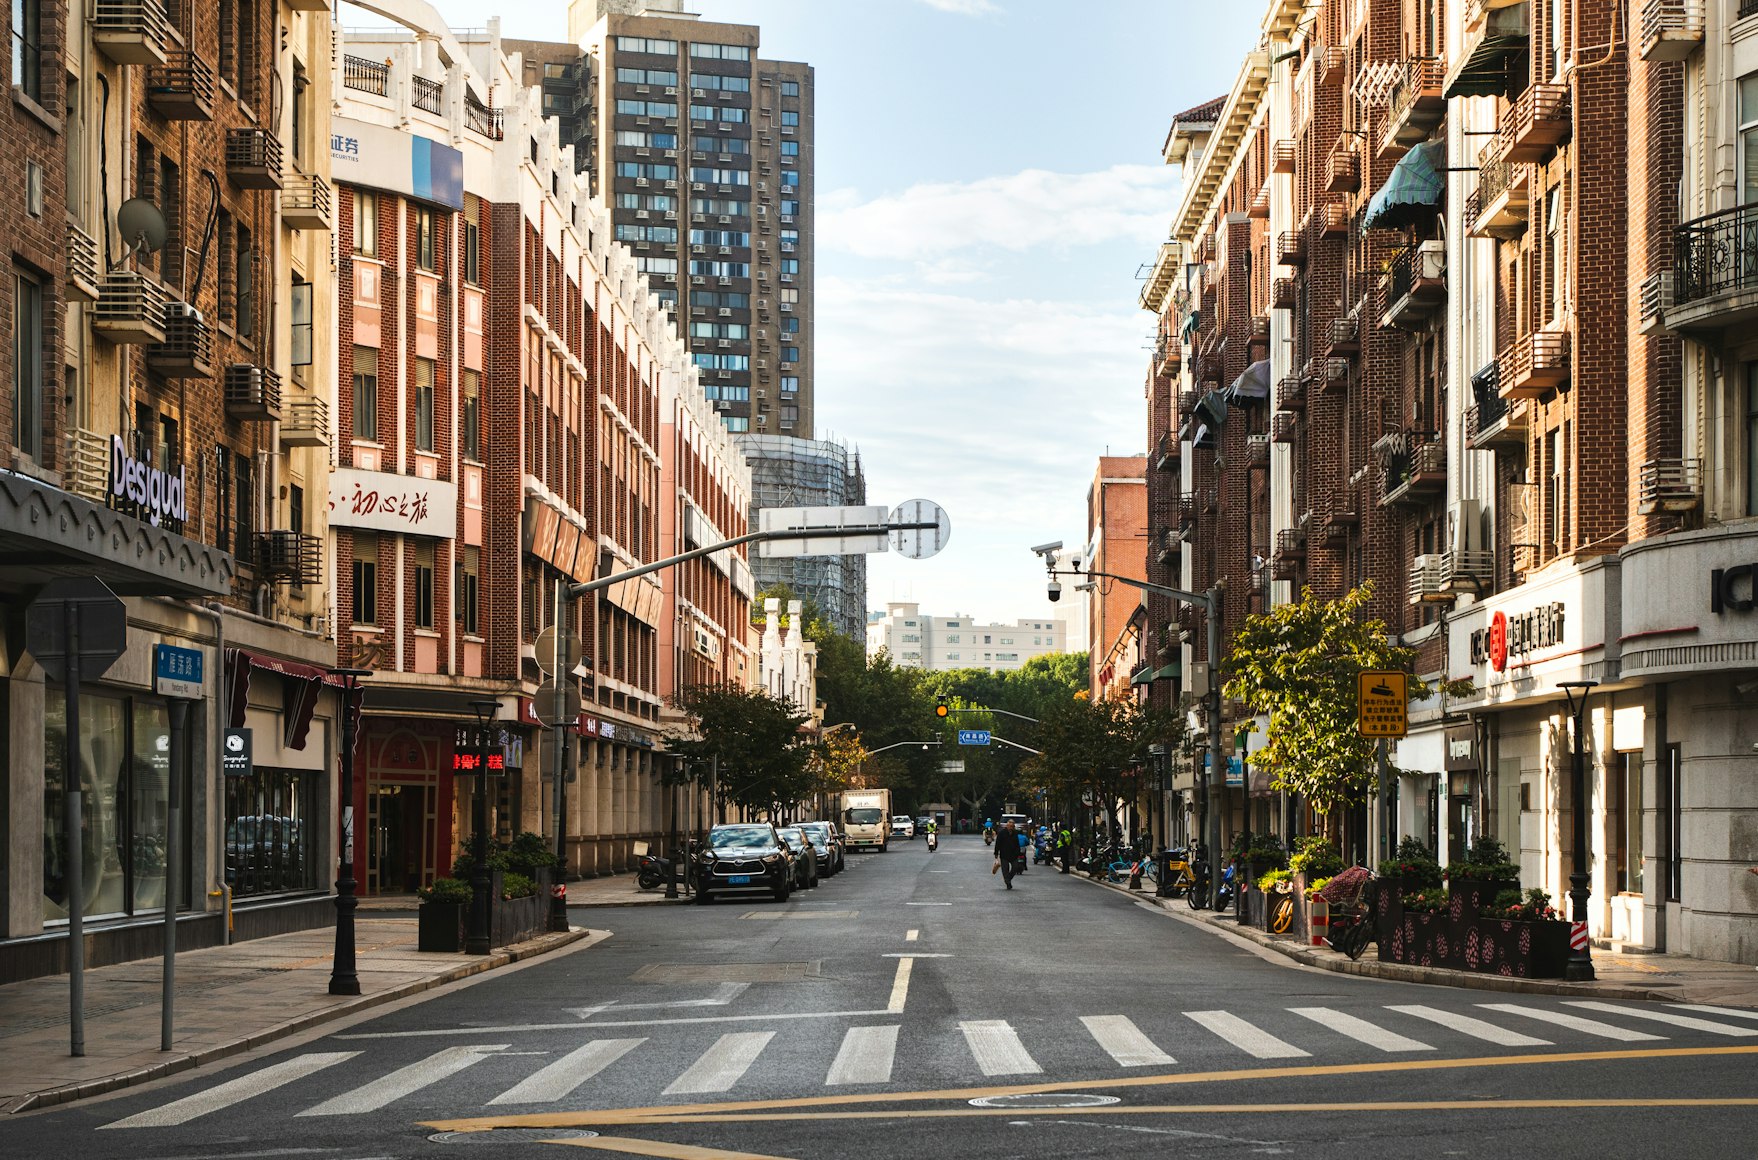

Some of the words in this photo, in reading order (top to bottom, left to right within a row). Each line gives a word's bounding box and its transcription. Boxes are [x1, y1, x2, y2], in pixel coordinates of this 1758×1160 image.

[330, 134, 358, 155] 证券
[329, 483, 428, 525] ·初心之旅
[1506, 602, 1565, 656] 中国工商银行
